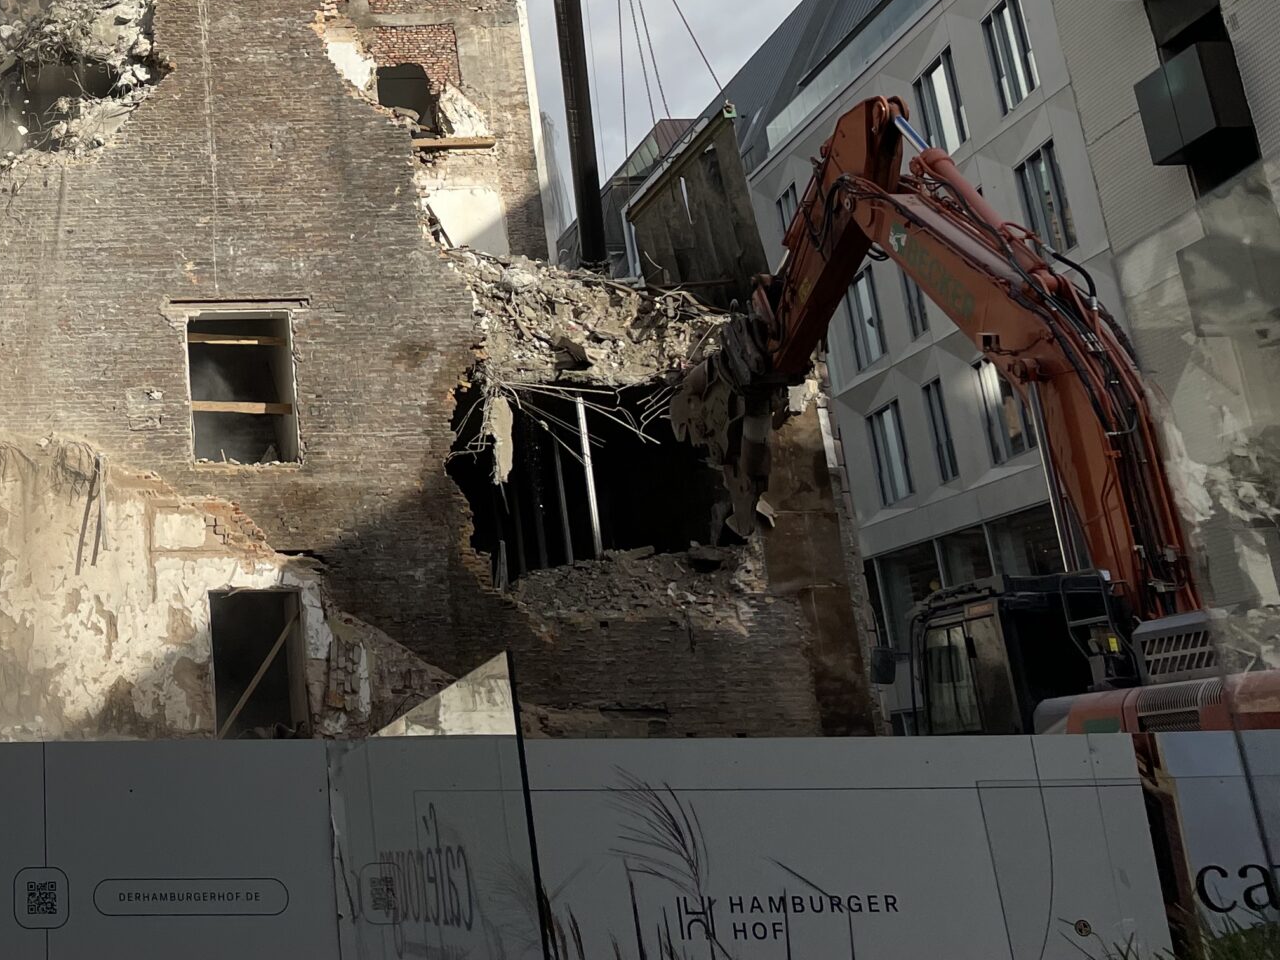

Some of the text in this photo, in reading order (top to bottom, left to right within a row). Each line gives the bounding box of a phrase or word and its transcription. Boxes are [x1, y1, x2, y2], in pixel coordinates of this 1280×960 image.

[906, 236, 975, 320] BECKER
[118, 891, 262, 902] DERHAMBURGERHOF.DE
[728, 895, 899, 914] HAMBURGER
[732, 922, 784, 940] HOF
